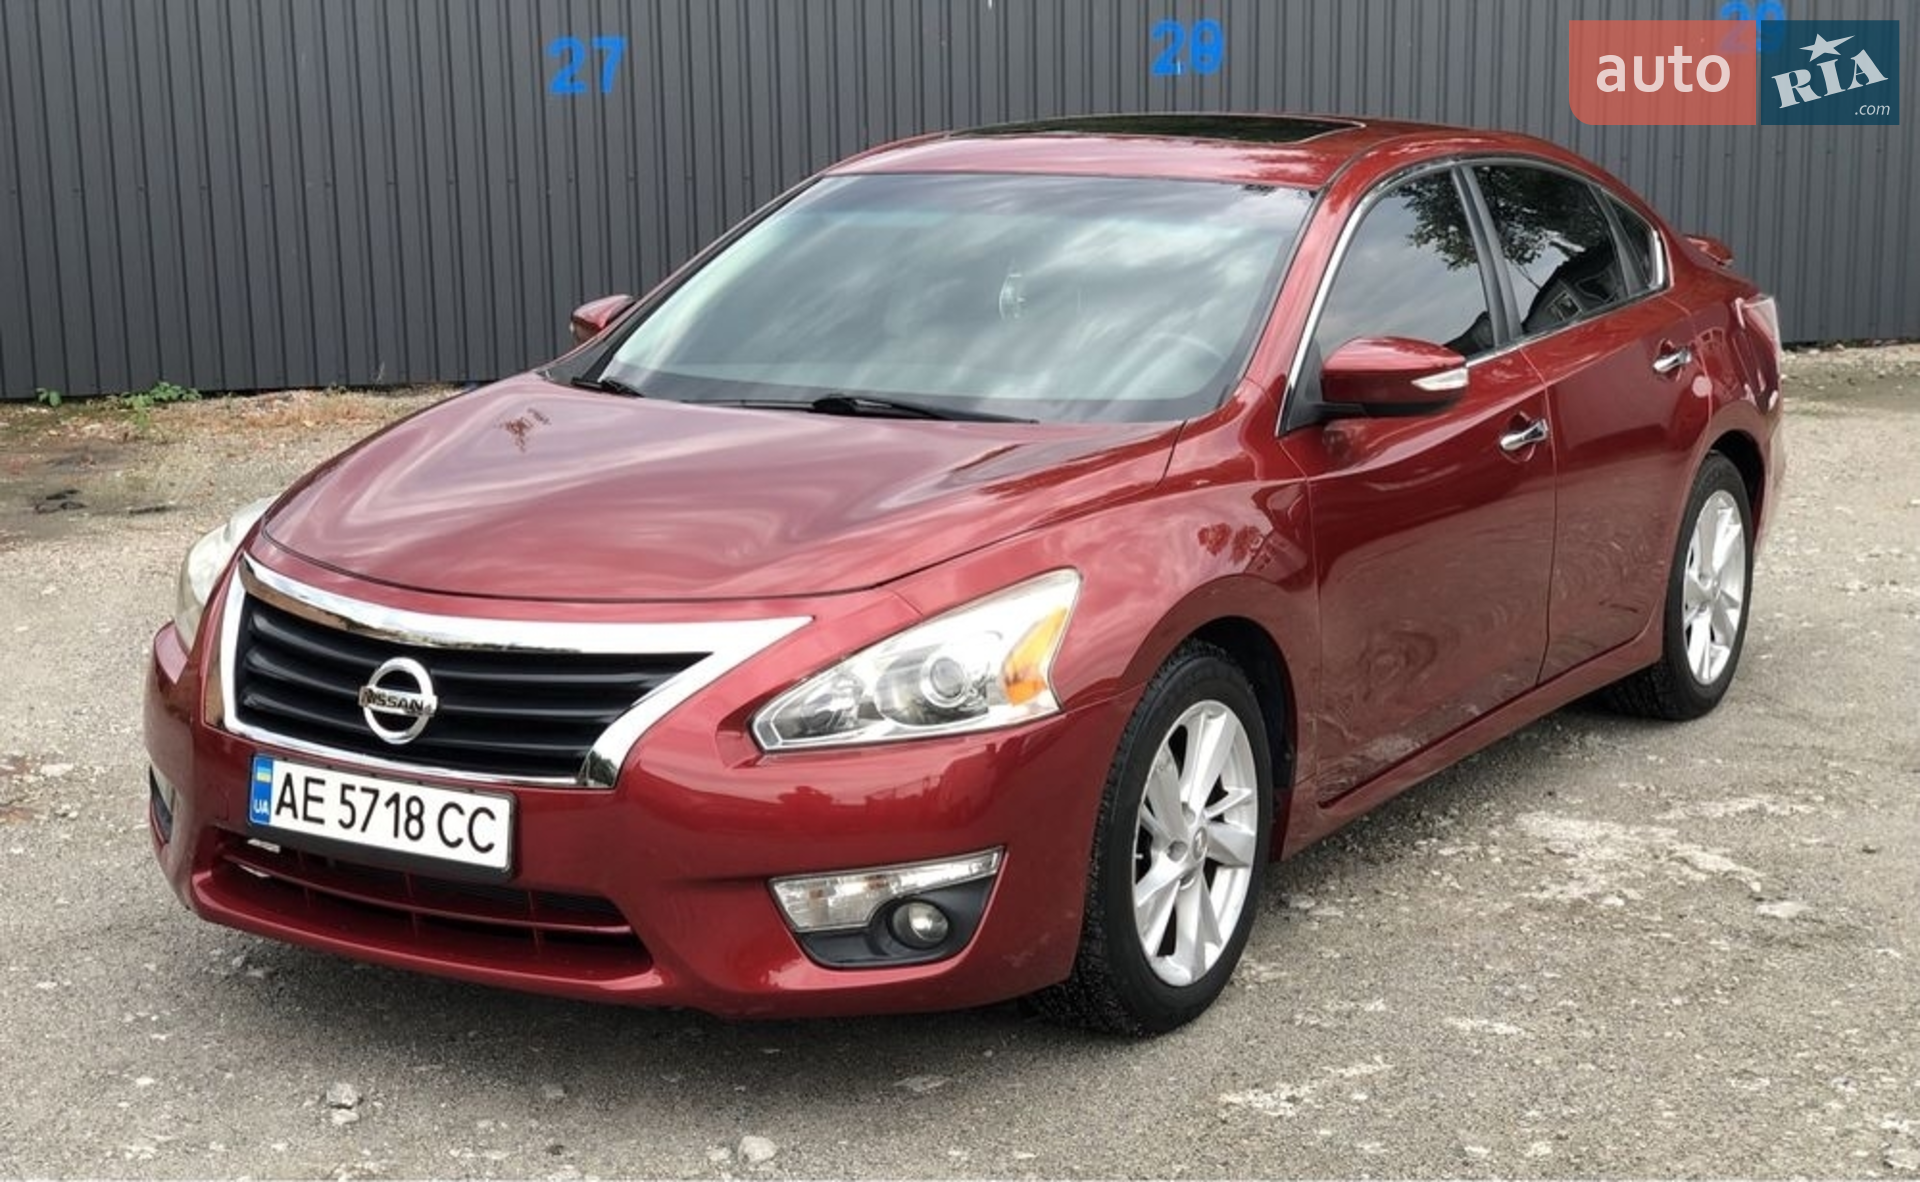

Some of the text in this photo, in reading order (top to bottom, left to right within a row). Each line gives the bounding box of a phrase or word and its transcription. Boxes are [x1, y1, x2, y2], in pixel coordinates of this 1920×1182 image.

[1151, 18, 1223, 75] 28
[1719, 0, 1785, 53] 29
[547, 35, 627, 93] 27
[362, 688, 424, 712] NISSAN
[253, 799, 270, 815] UA
[275, 772, 496, 854] AE 5718 CC
